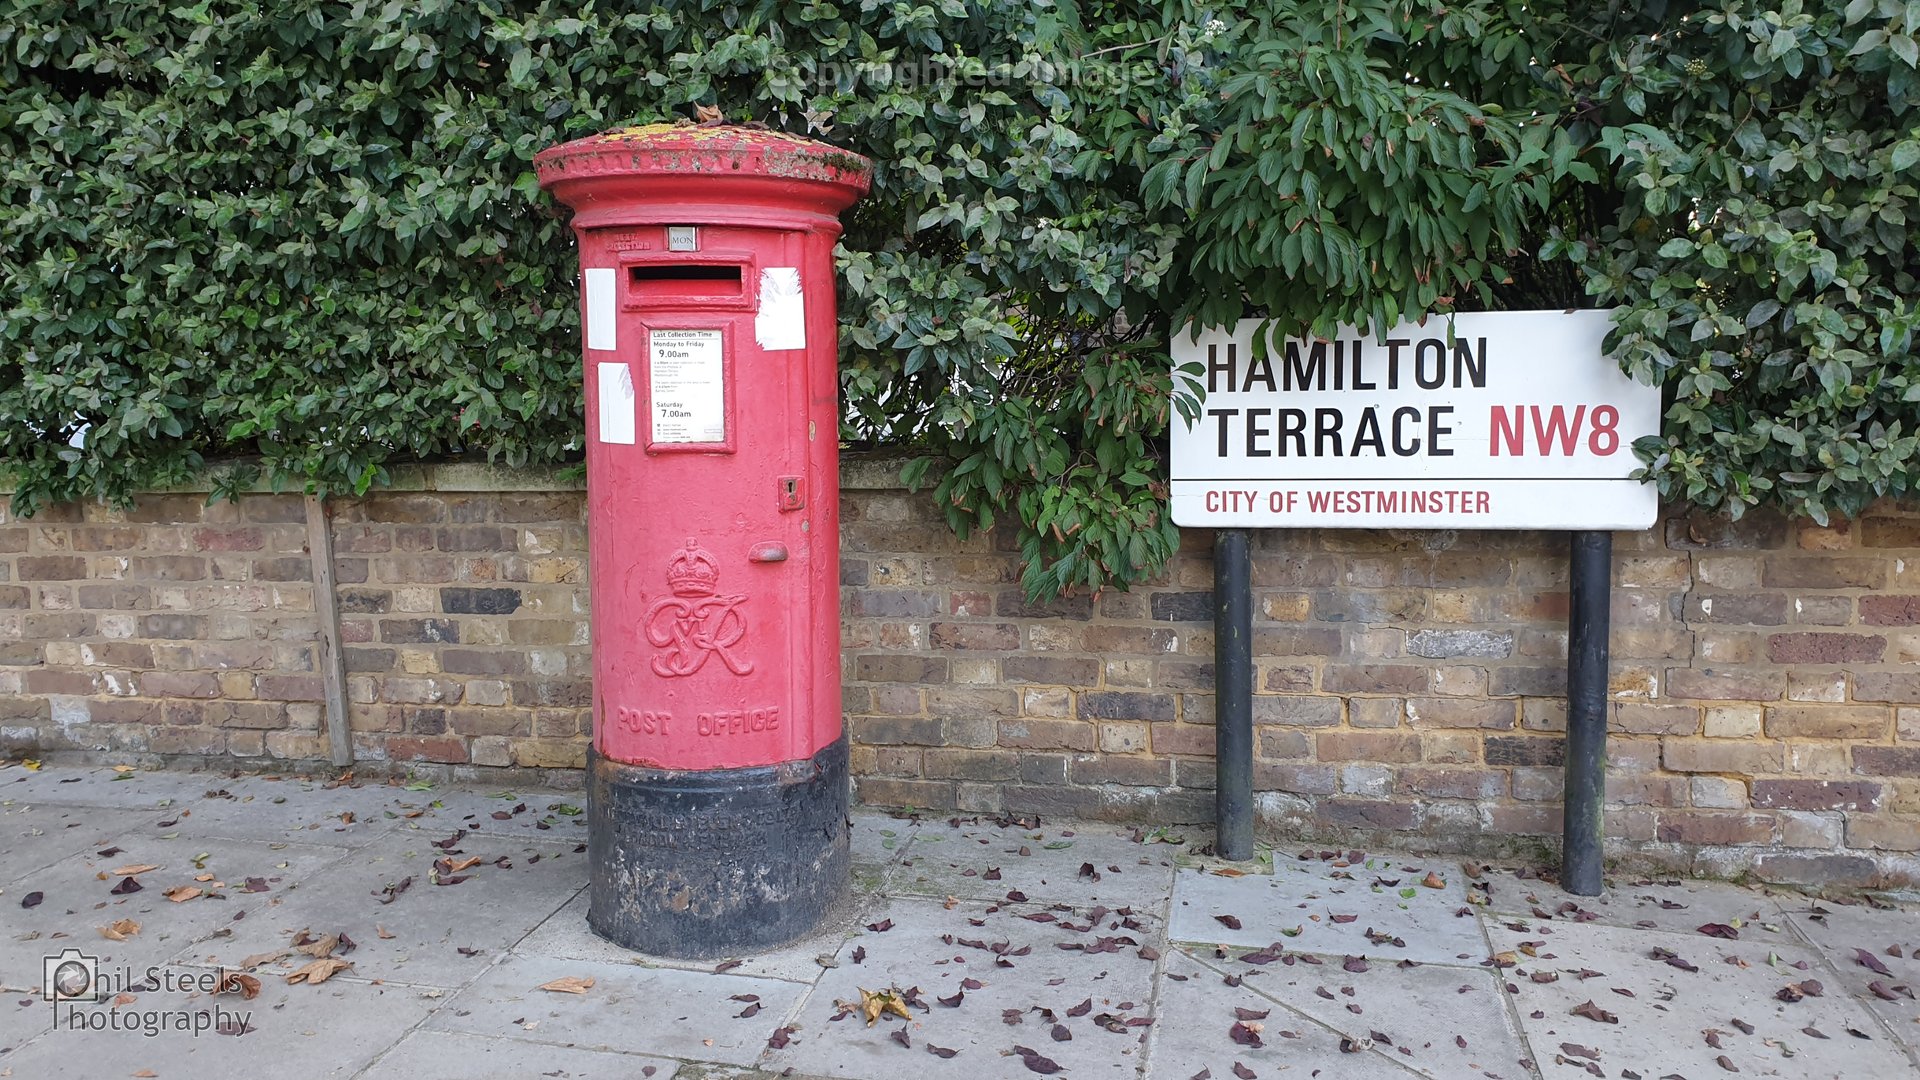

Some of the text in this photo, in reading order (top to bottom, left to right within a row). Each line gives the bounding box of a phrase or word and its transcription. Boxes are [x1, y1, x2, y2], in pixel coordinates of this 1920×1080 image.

[672, 236, 693, 244] MON
[659, 349, 689, 358] 9.00am
[1207, 337, 1487, 393] HAMILTON
[661, 409, 691, 418] 7.00am
[1207, 404, 1620, 458] TERRACE NW8
[1205, 490, 1490, 514] CITY OF WESTMINSTER
[618, 705, 779, 736] POST OFFICE
